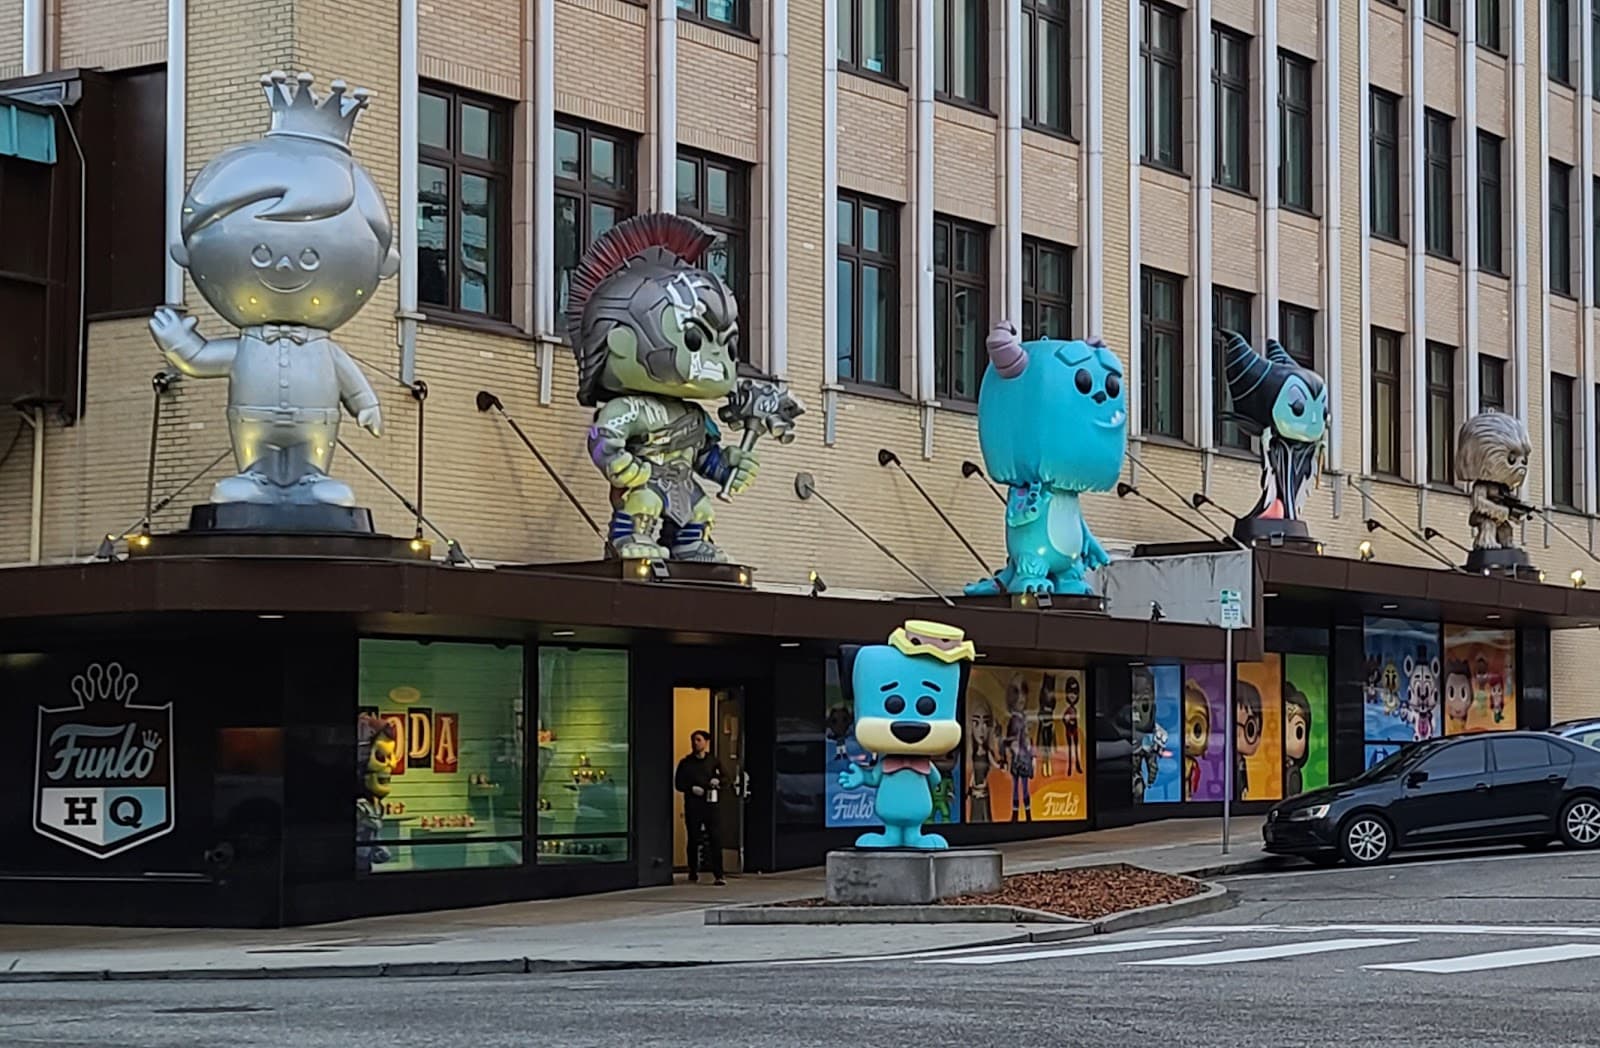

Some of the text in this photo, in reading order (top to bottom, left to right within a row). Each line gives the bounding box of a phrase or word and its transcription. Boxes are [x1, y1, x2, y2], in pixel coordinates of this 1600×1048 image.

[46, 722, 155, 779] Funko
[361, 712, 457, 764] ODA
[832, 792, 874, 820] Funko
[1042, 791, 1079, 816] Funko
